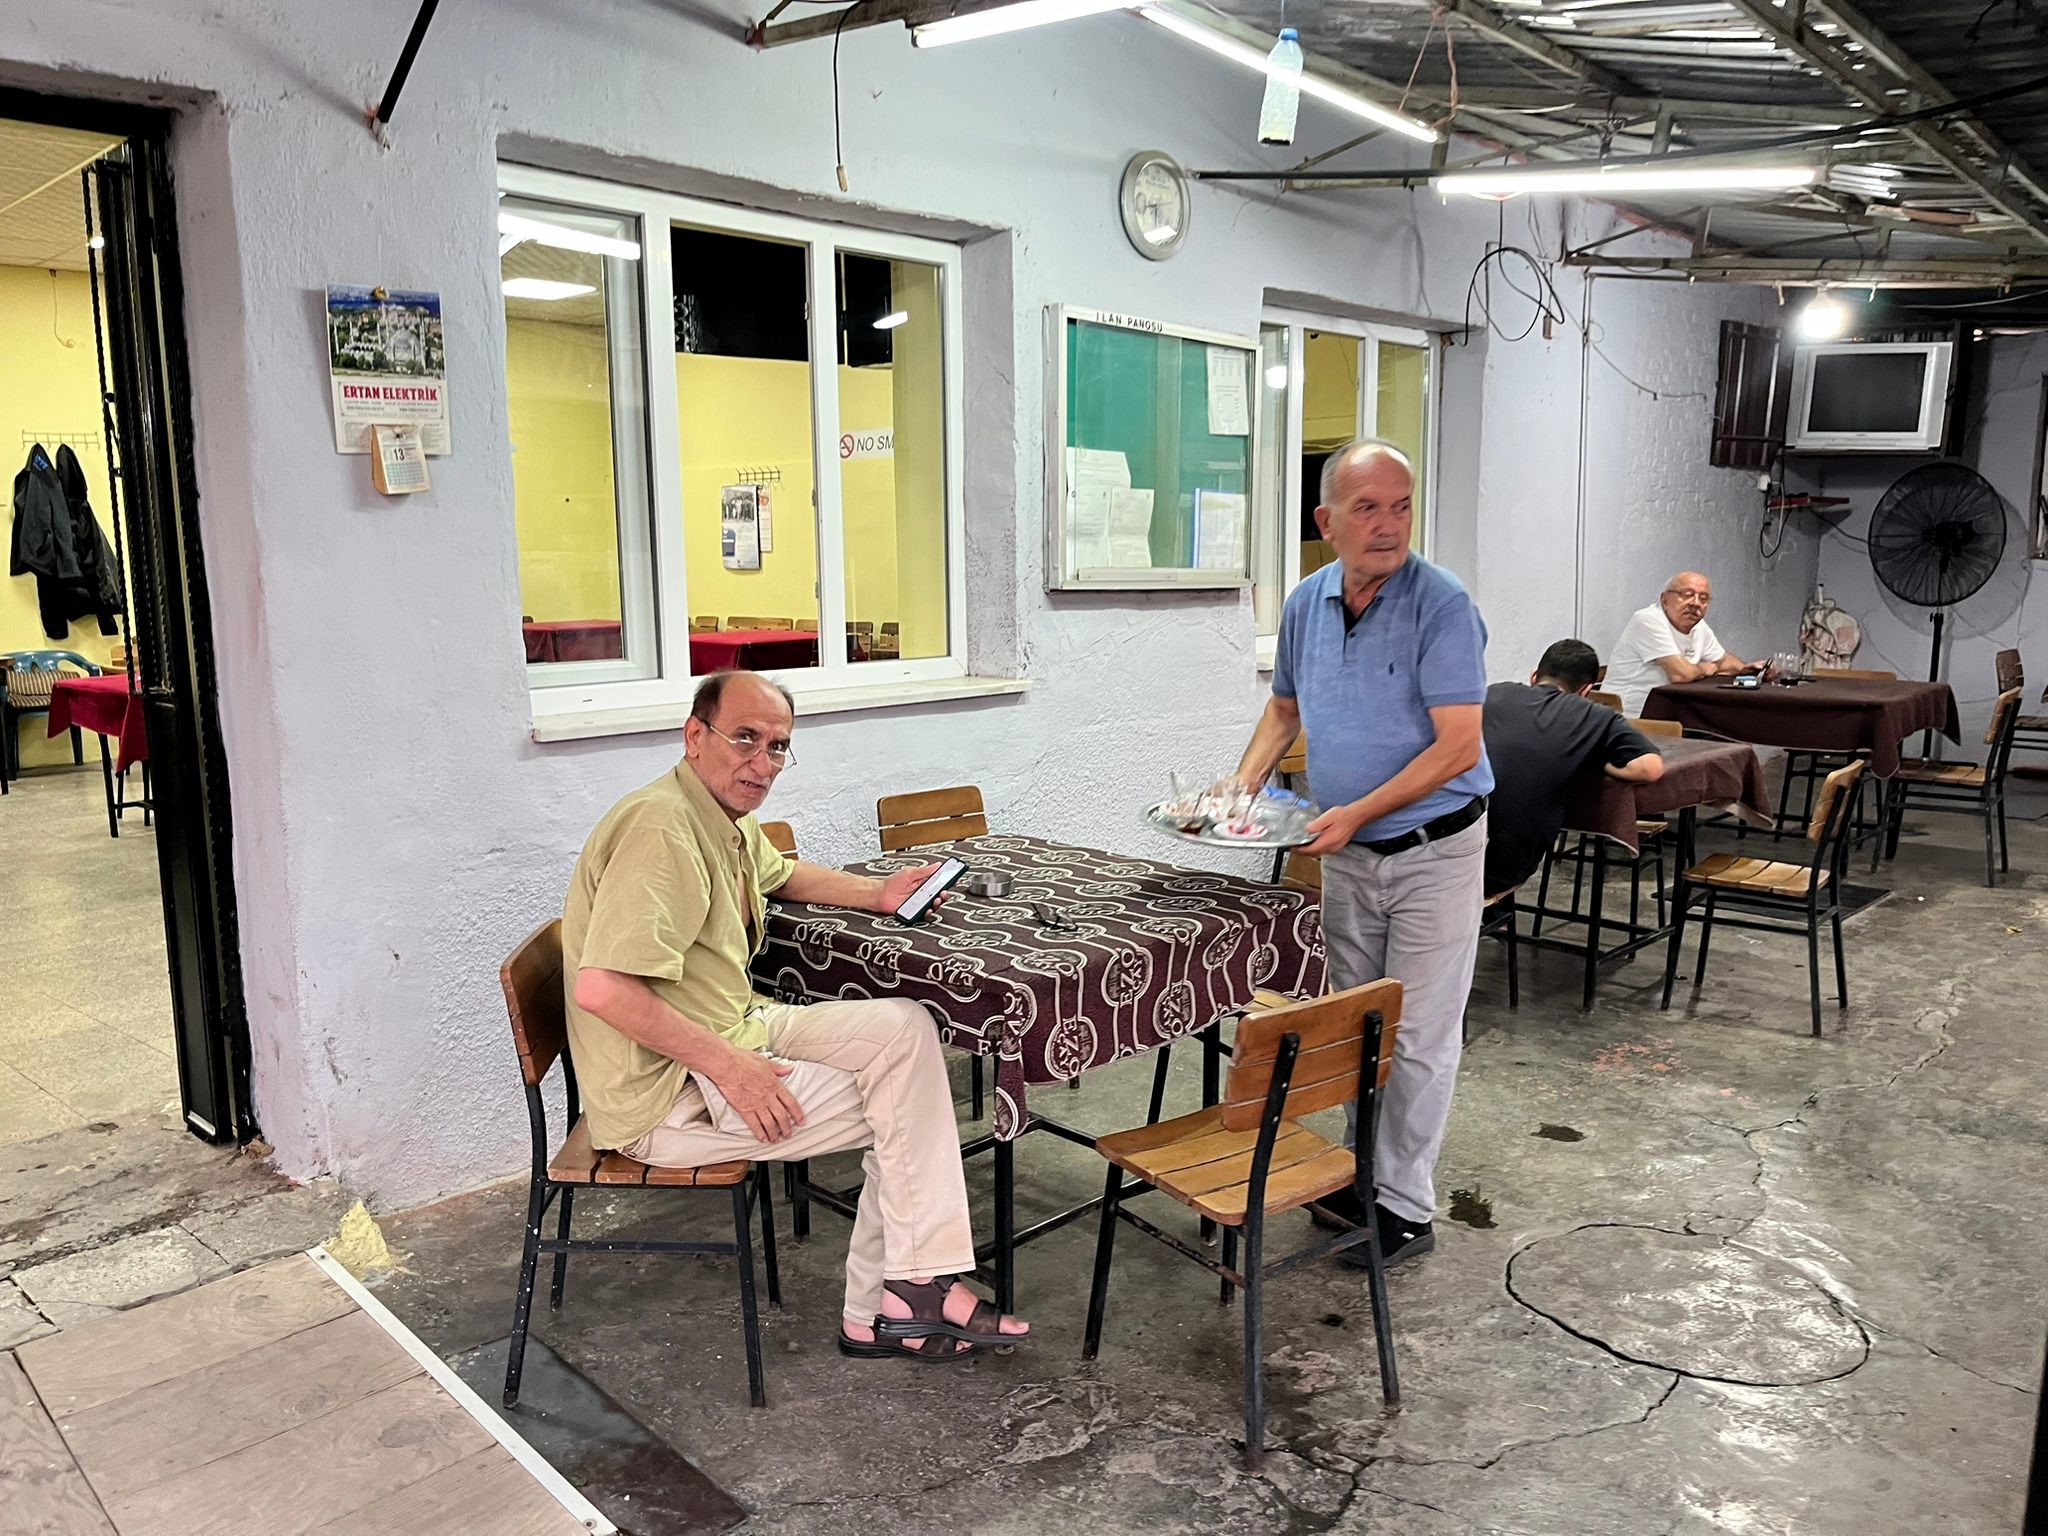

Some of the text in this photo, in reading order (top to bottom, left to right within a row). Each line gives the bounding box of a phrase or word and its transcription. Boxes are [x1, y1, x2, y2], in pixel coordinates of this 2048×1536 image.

[1127, 317, 1163, 332] PANOSU
[343, 385, 438, 401] ERTAN ELEKTRİK
[856, 436, 874, 451] NO
[393, 447, 405, 461] 13
